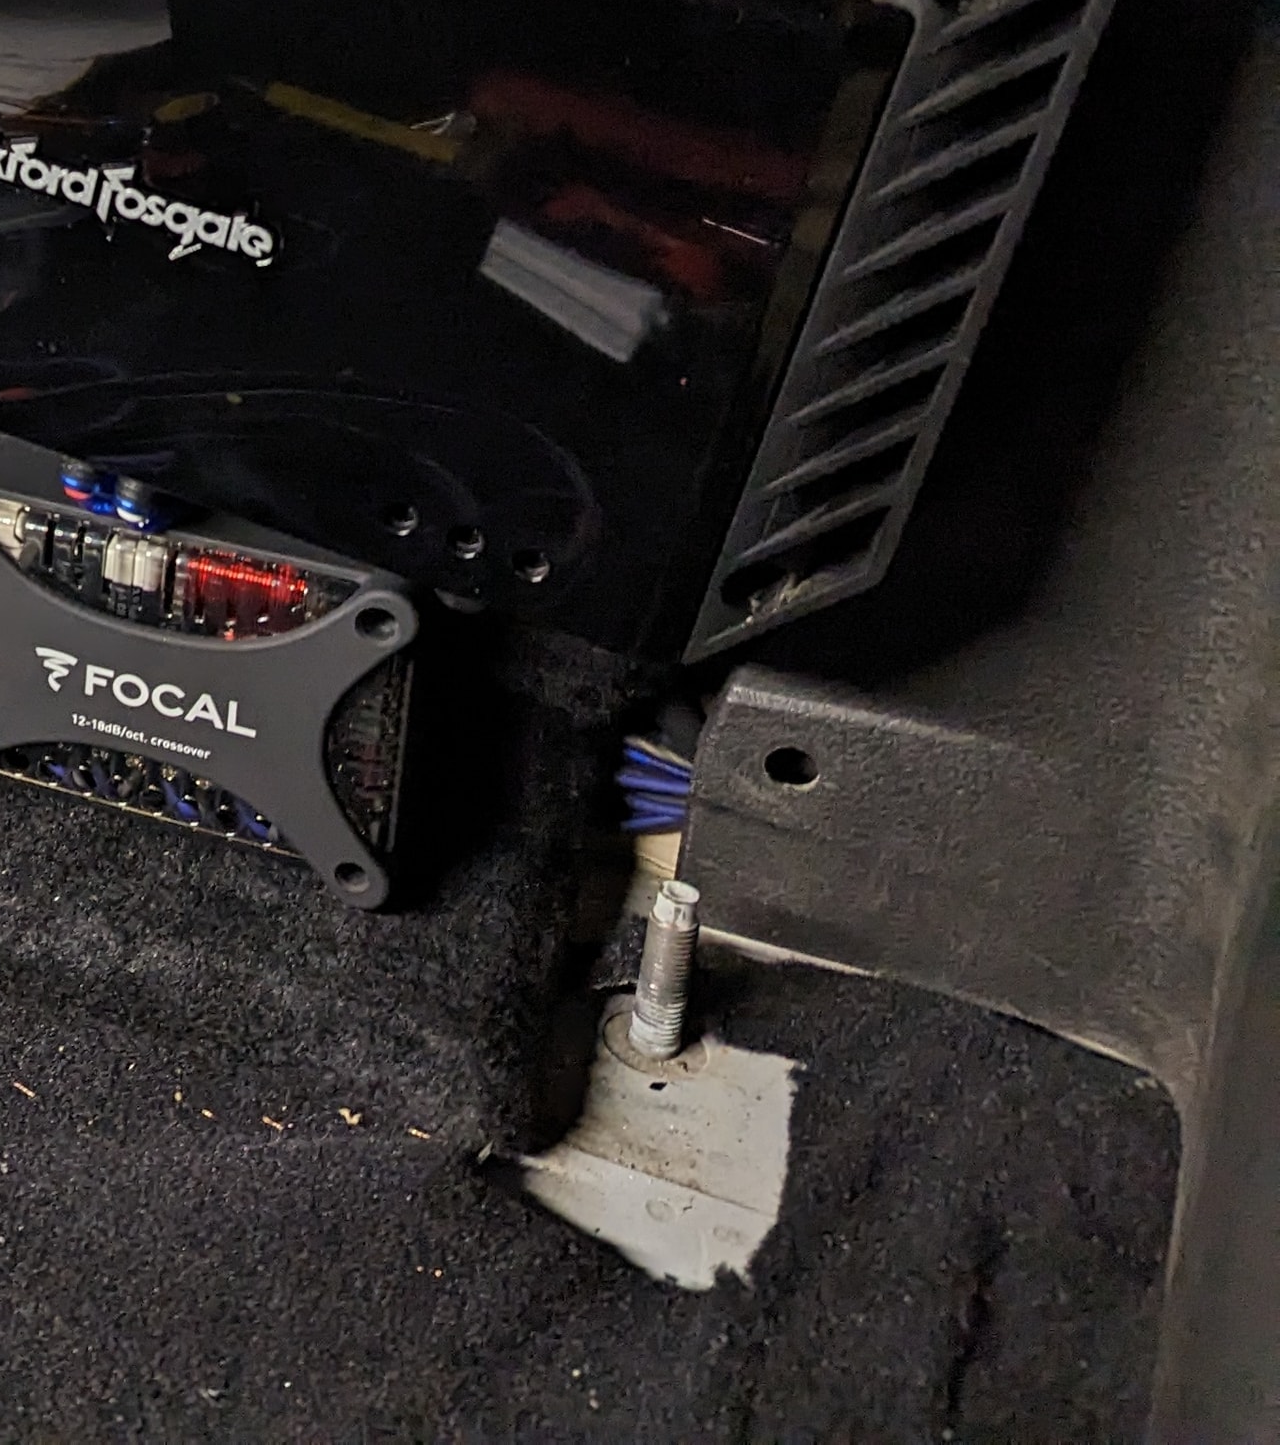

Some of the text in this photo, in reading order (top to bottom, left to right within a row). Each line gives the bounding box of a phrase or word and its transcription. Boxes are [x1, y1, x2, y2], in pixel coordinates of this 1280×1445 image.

[96, 164, 274, 260] Fosgate
[72, 713, 211, 760] 12-18dB/oct. crossover
[84, 664, 257, 739] FOCAL
